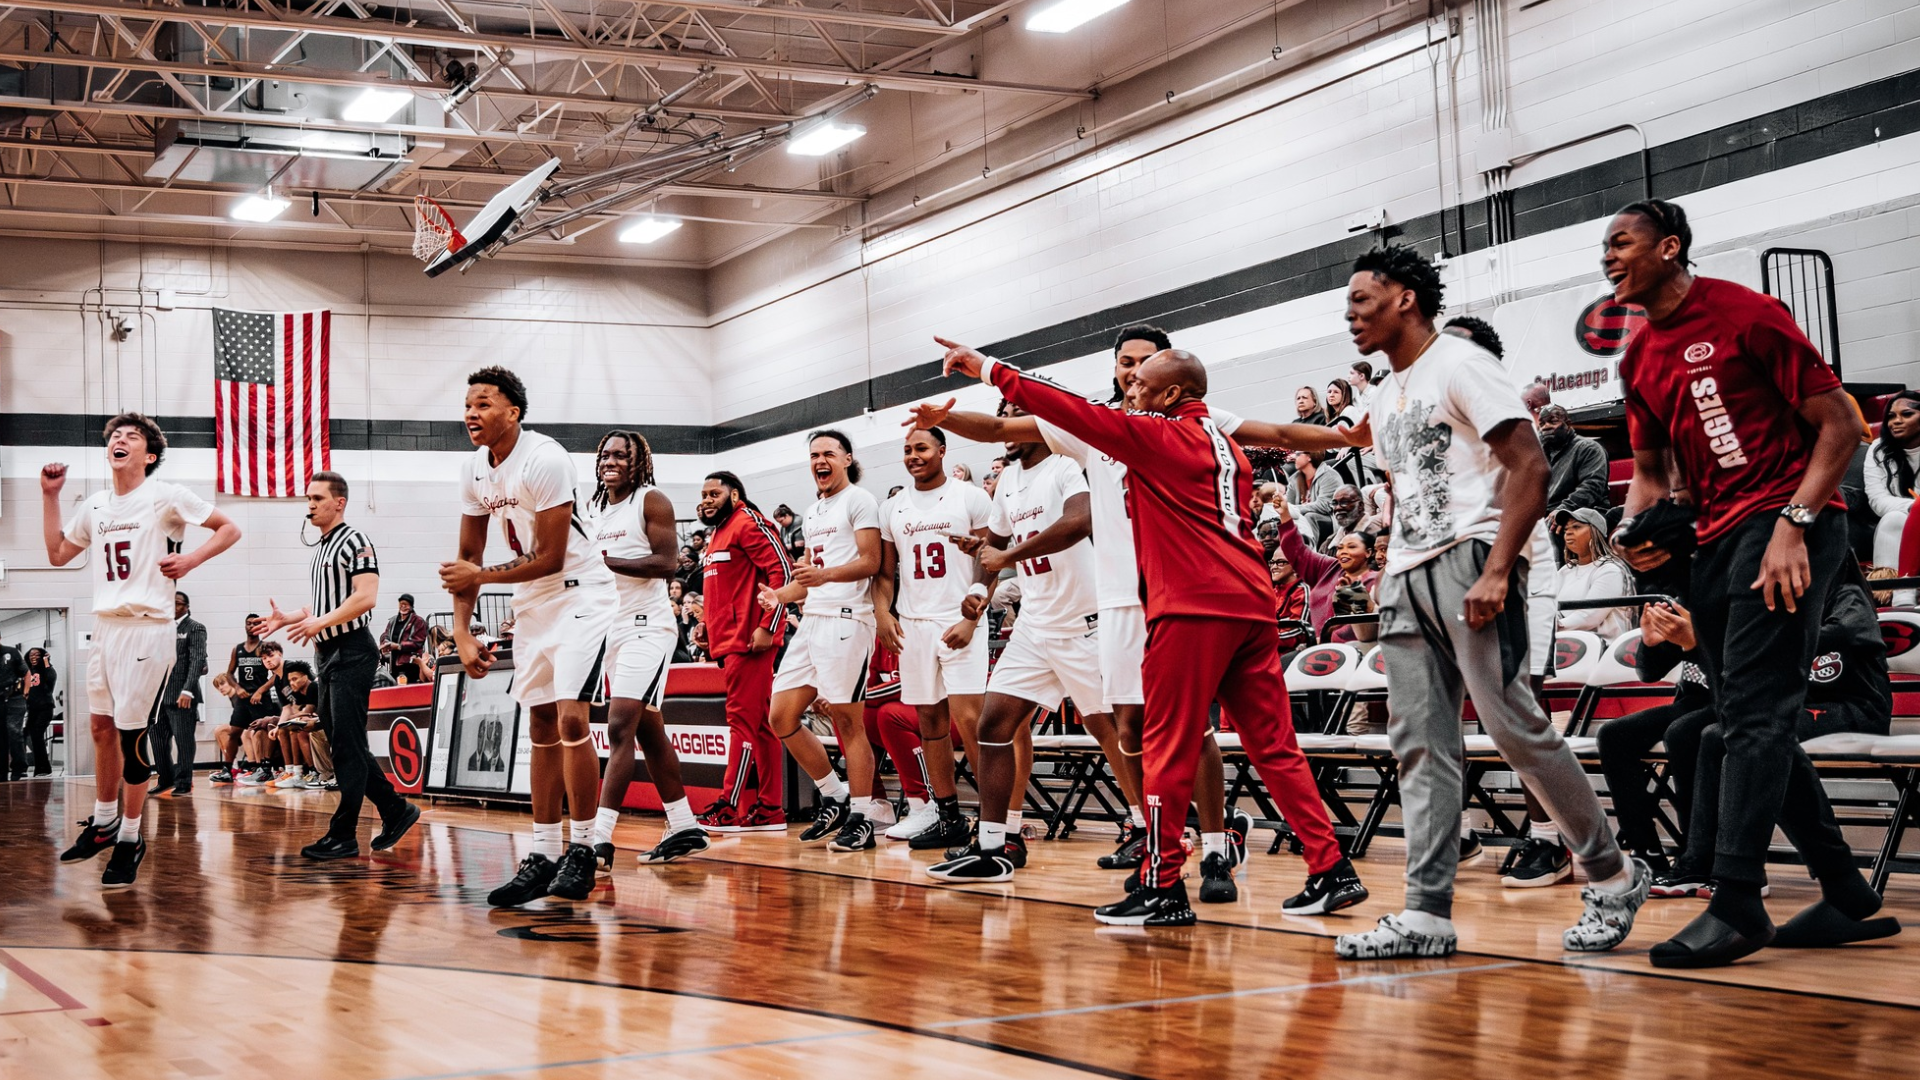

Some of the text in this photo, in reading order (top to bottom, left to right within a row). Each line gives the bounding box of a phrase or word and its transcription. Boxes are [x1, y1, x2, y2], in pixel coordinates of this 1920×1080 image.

[1690, 377, 1749, 469] AGGIES
[97, 520, 141, 537] Sylacauga
[903, 521, 952, 537] Sylacauga
[104, 540, 131, 582] 15
[913, 542, 947, 580] 13
[244, 666, 254, 680] 2
[1304, 650, 1341, 675] S
[392, 723, 419, 781] S
[671, 732, 727, 756] AGGIES
[1146, 794, 1162, 807] SYL
